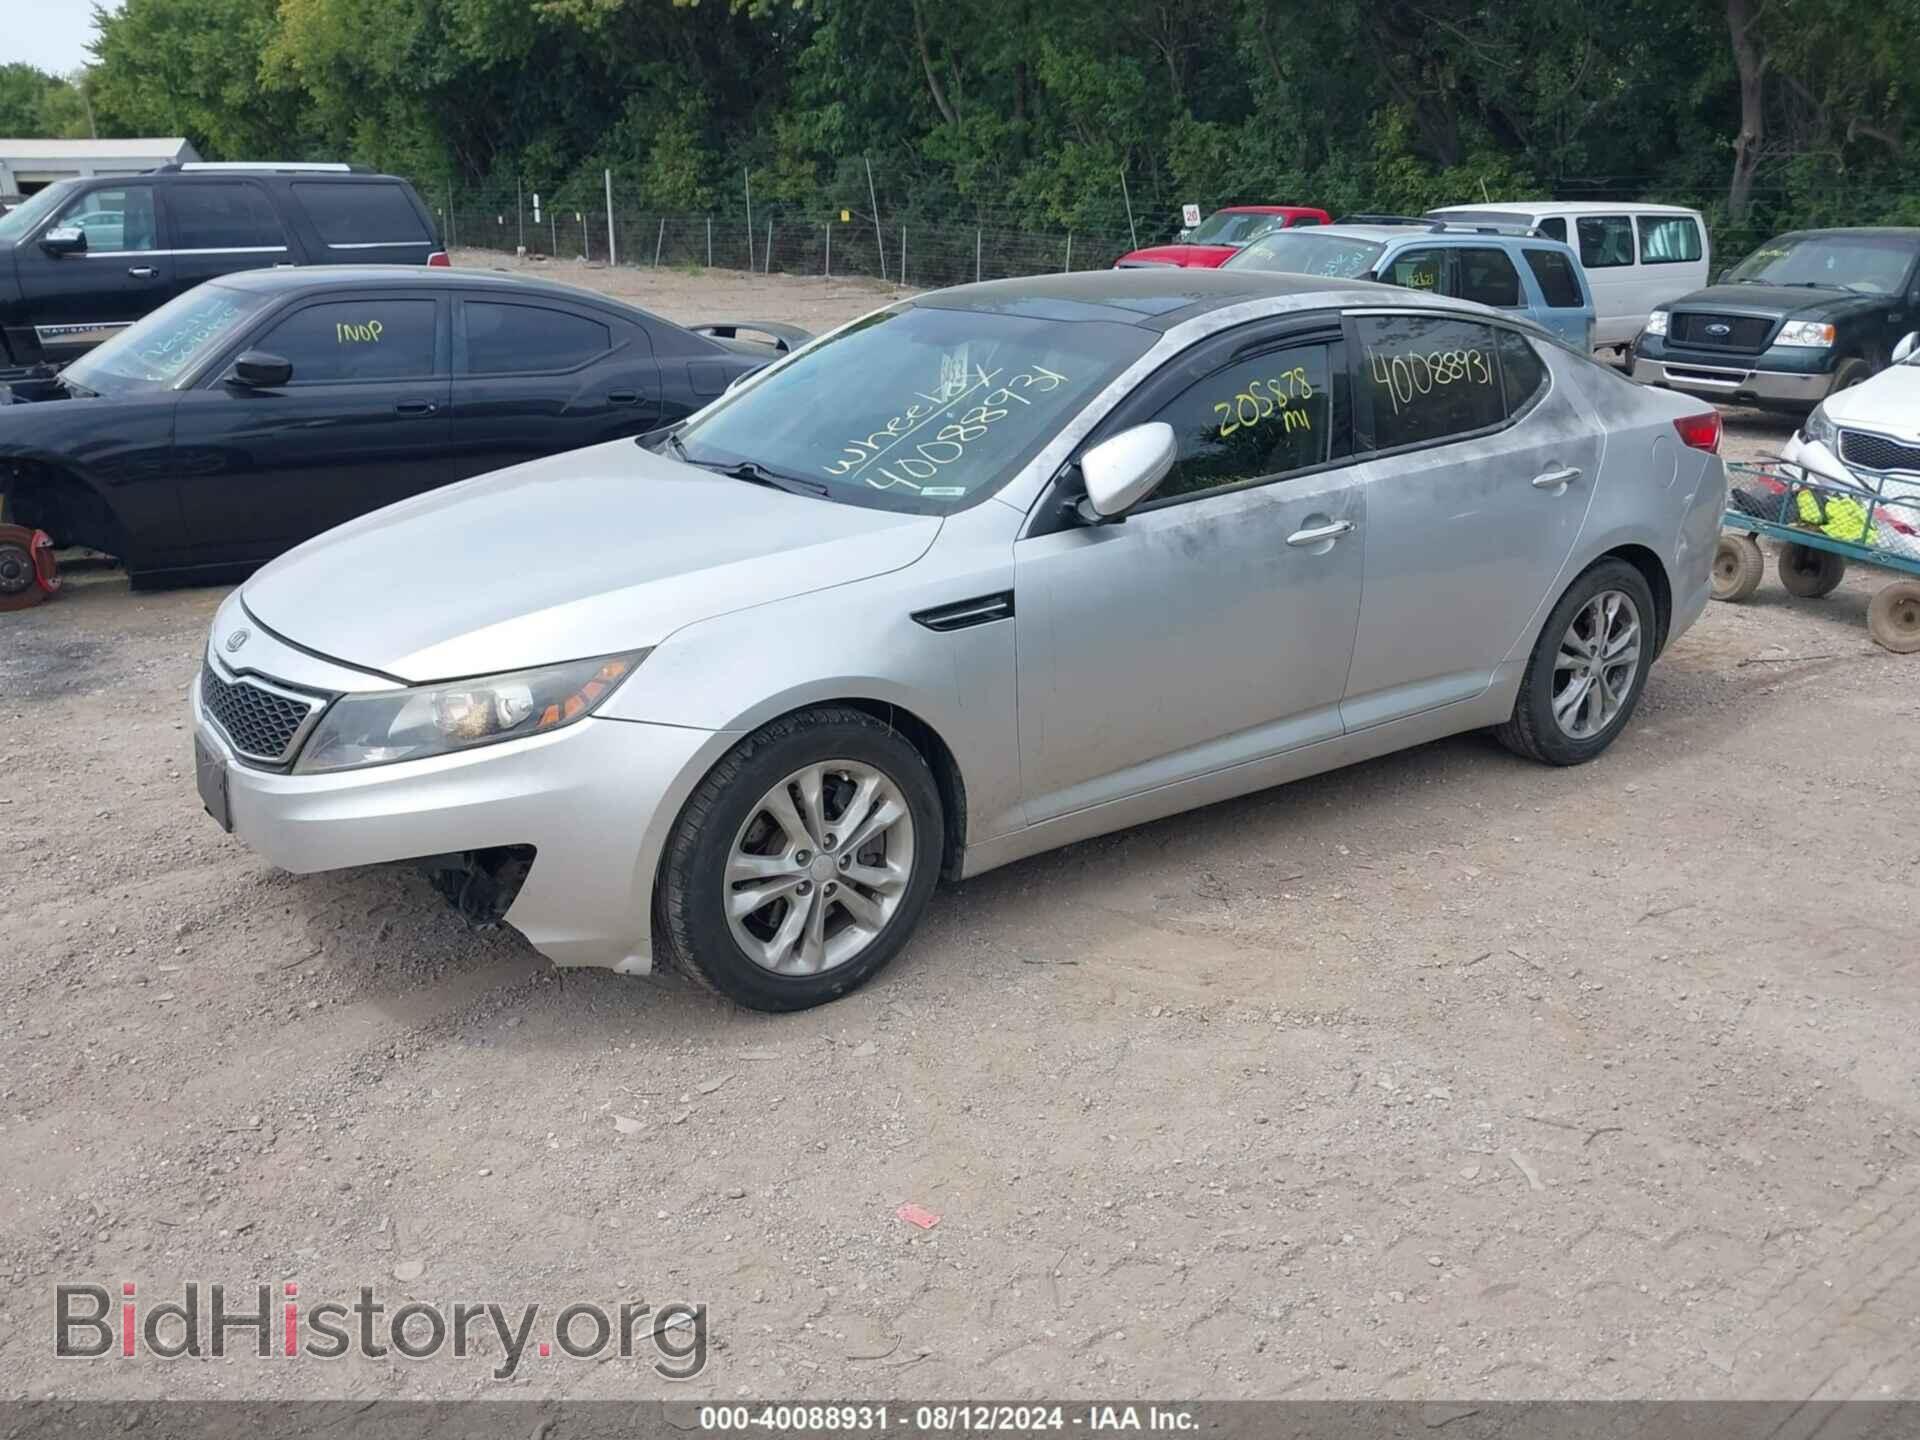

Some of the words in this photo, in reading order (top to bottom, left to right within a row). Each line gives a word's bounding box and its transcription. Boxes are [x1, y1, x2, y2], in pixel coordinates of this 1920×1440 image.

[1214, 367, 1313, 436] 205878
[1367, 344, 1493, 415] 40088931
[865, 365, 1069, 489] 40088931
